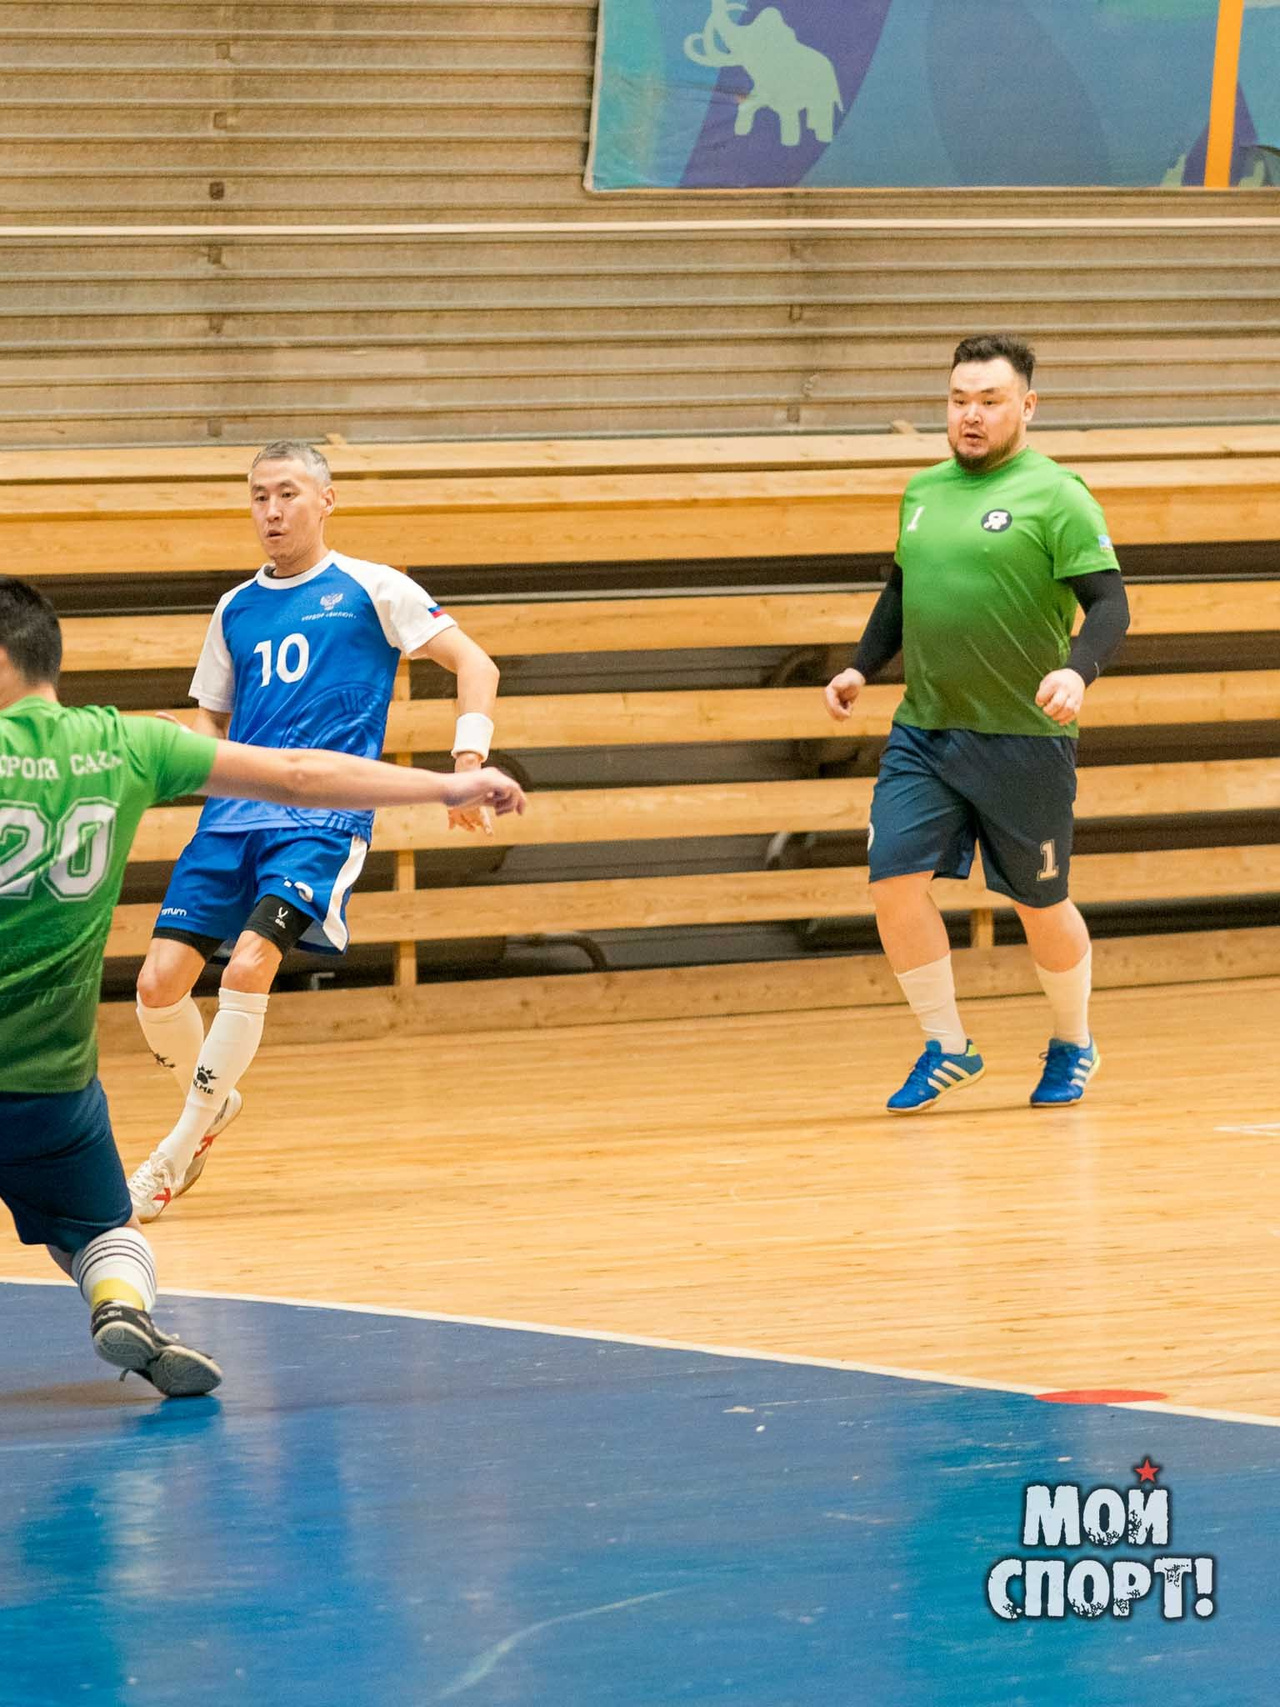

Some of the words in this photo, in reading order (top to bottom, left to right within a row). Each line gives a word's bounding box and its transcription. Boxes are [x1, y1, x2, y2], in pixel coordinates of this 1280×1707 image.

[906, 505, 924, 532] 1
[253, 632, 310, 688] 10
[1036, 838, 1060, 881] 1
